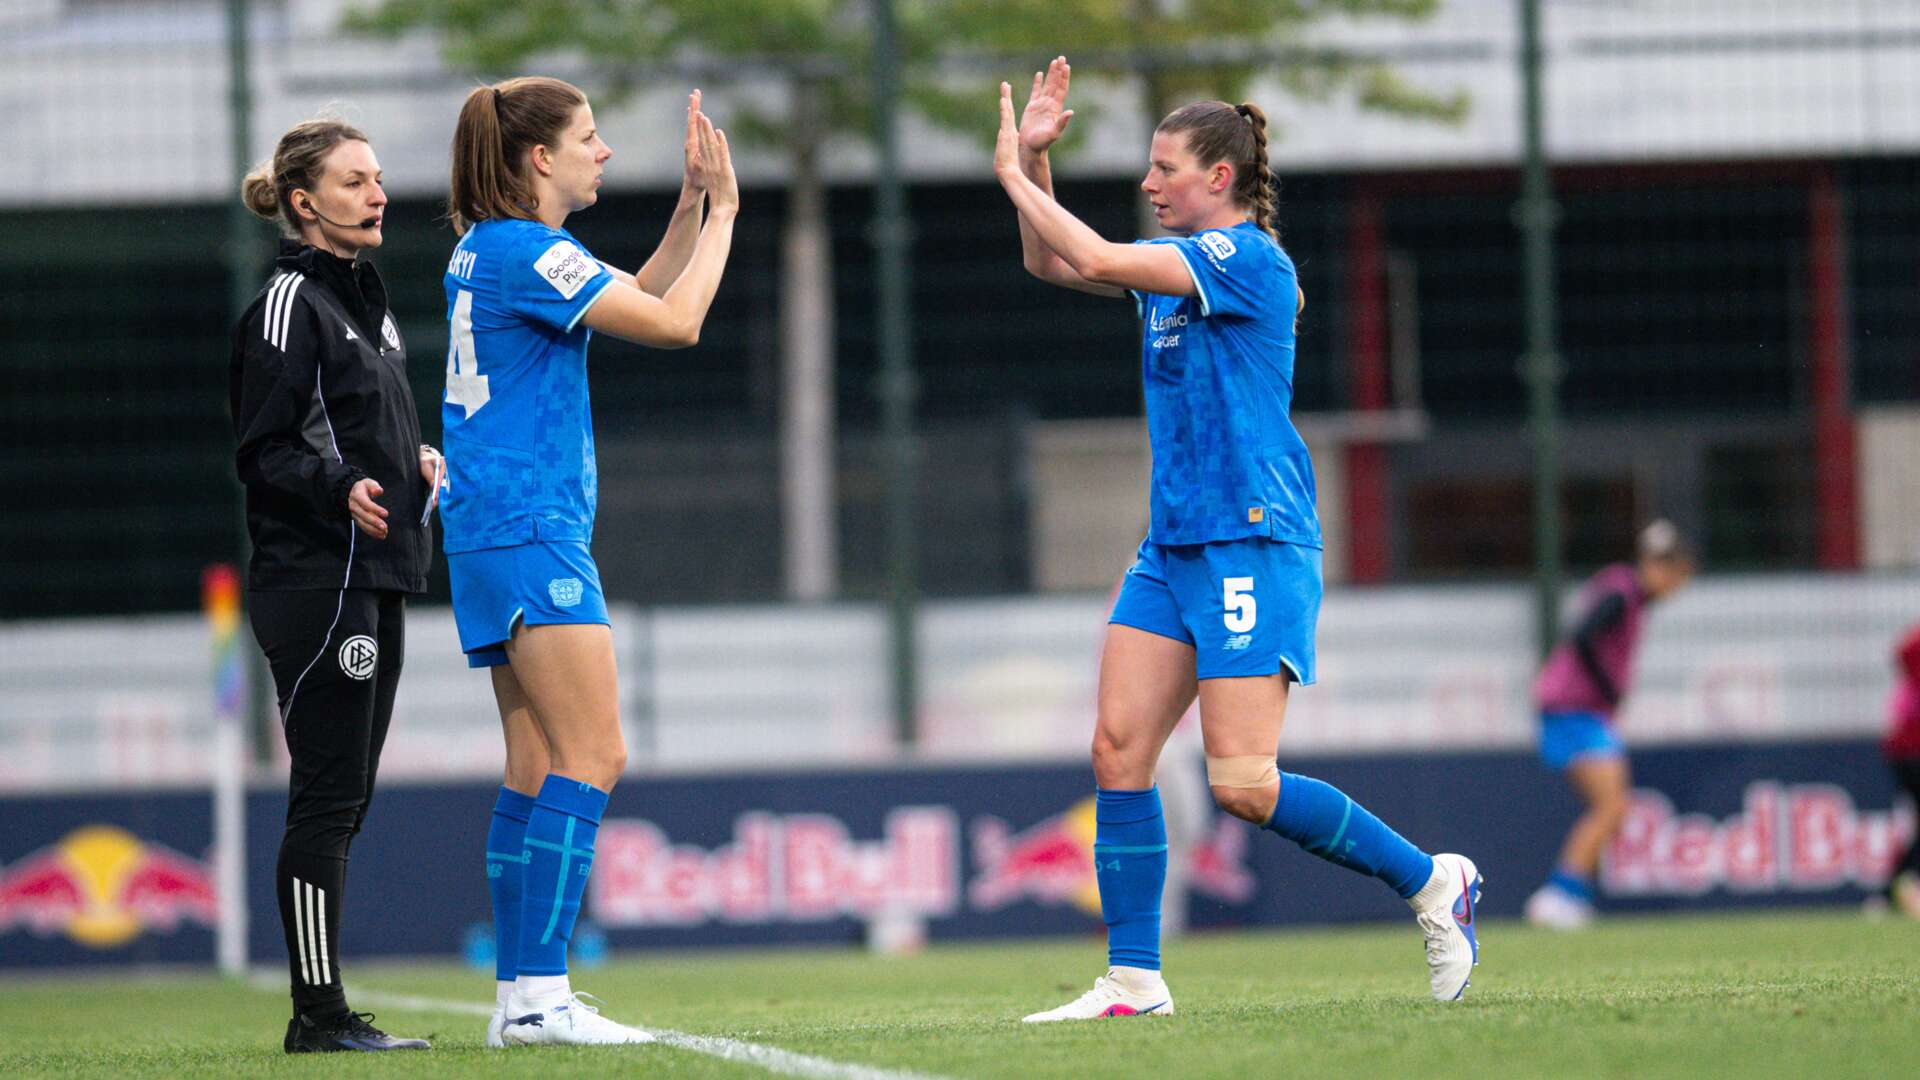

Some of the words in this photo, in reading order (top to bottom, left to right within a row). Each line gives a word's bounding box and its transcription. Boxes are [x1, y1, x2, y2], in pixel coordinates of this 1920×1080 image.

[547, 249, 582, 280] Google
[562, 263, 588, 285] Pixel
[445, 290, 491, 420] 4
[1223, 576, 1257, 633] 5
